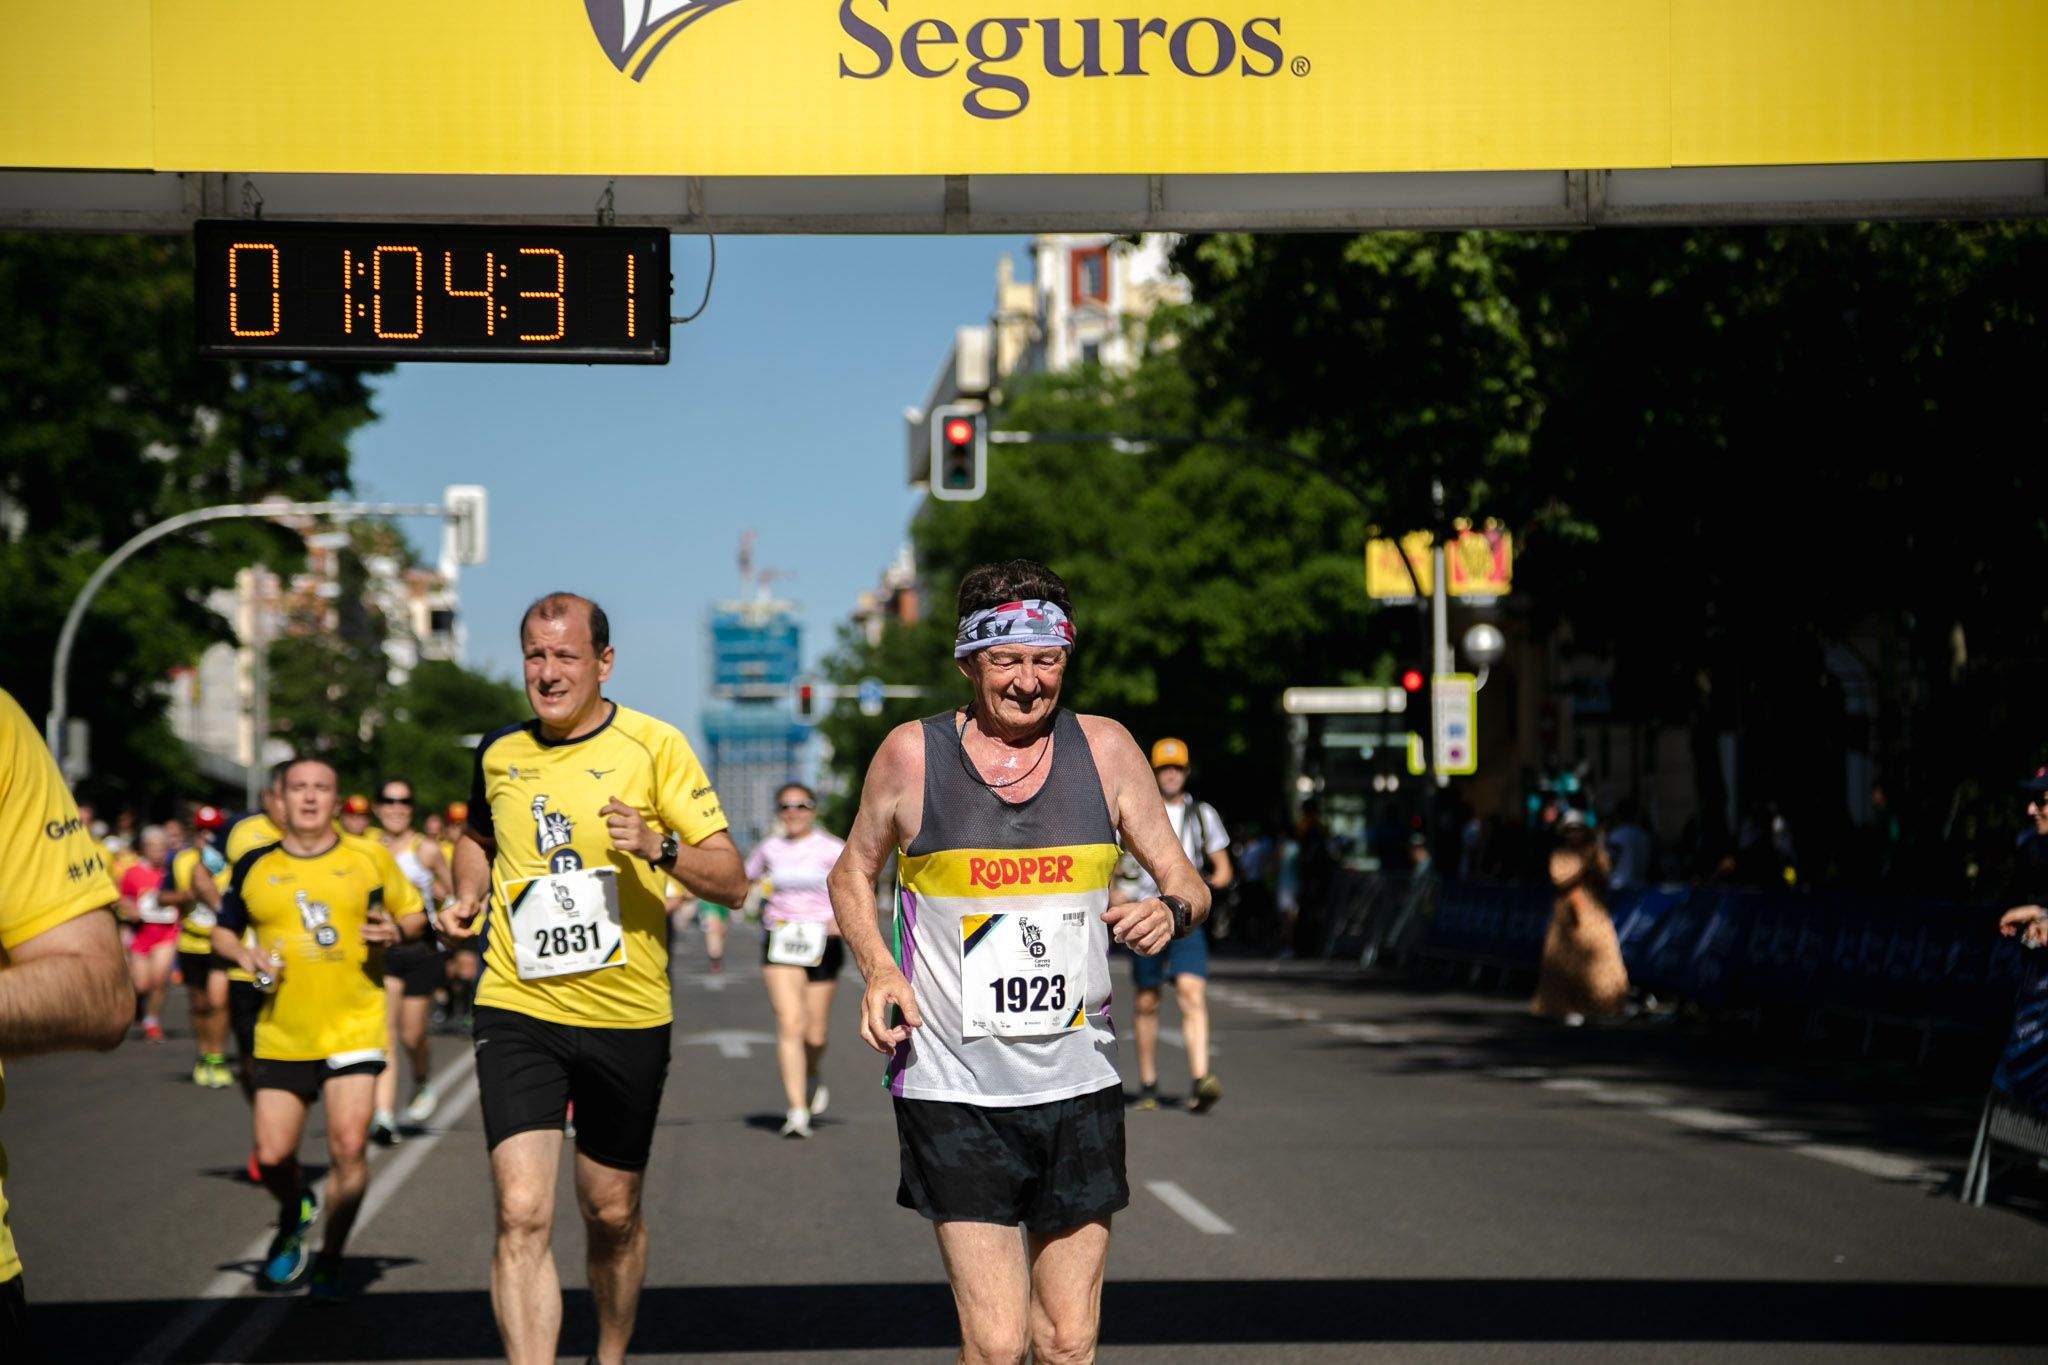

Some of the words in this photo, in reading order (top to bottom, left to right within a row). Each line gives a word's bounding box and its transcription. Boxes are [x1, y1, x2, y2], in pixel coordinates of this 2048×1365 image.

[229, 243, 635, 341] 01:04:31
[554, 854, 577, 873] 13
[970, 855, 1074, 890] RODPER
[535, 922, 600, 958] 2831
[1032, 945, 1043, 955] 13
[989, 974, 1066, 1013] 1923
